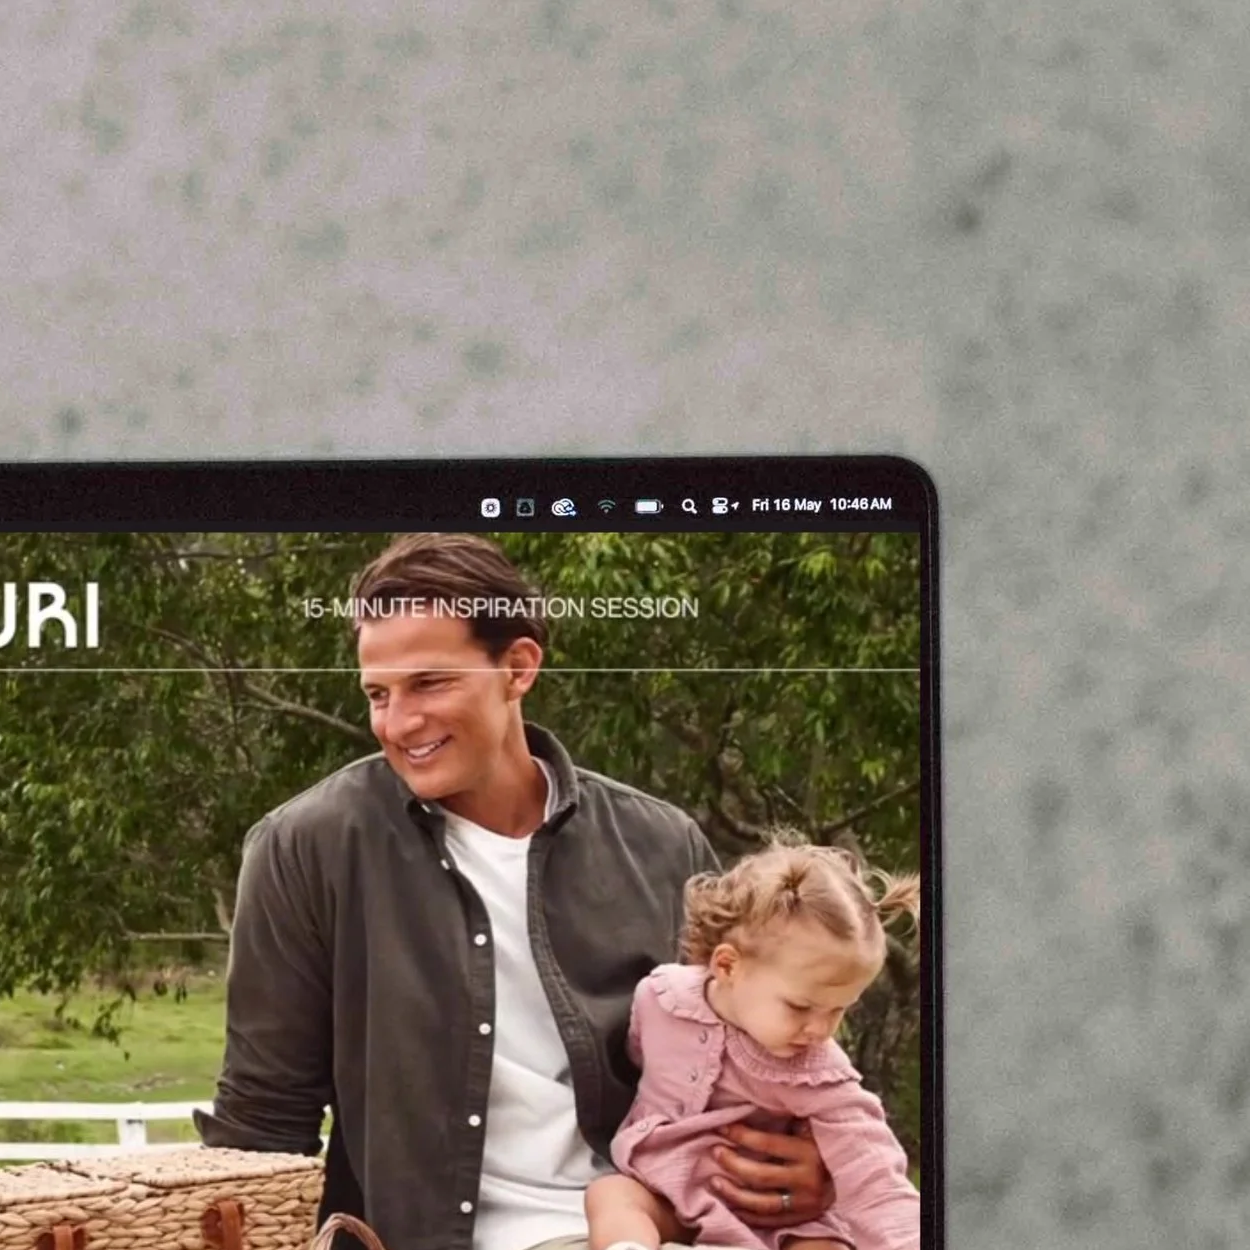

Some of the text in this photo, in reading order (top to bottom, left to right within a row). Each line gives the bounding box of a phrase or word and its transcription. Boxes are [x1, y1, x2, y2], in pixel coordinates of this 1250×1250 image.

[752, 498, 770, 511] Fri
[773, 498, 791, 511] 16
[794, 497, 822, 514] May
[301, 597, 699, 619] 15-MINUTE INSPIRATION SESSION
